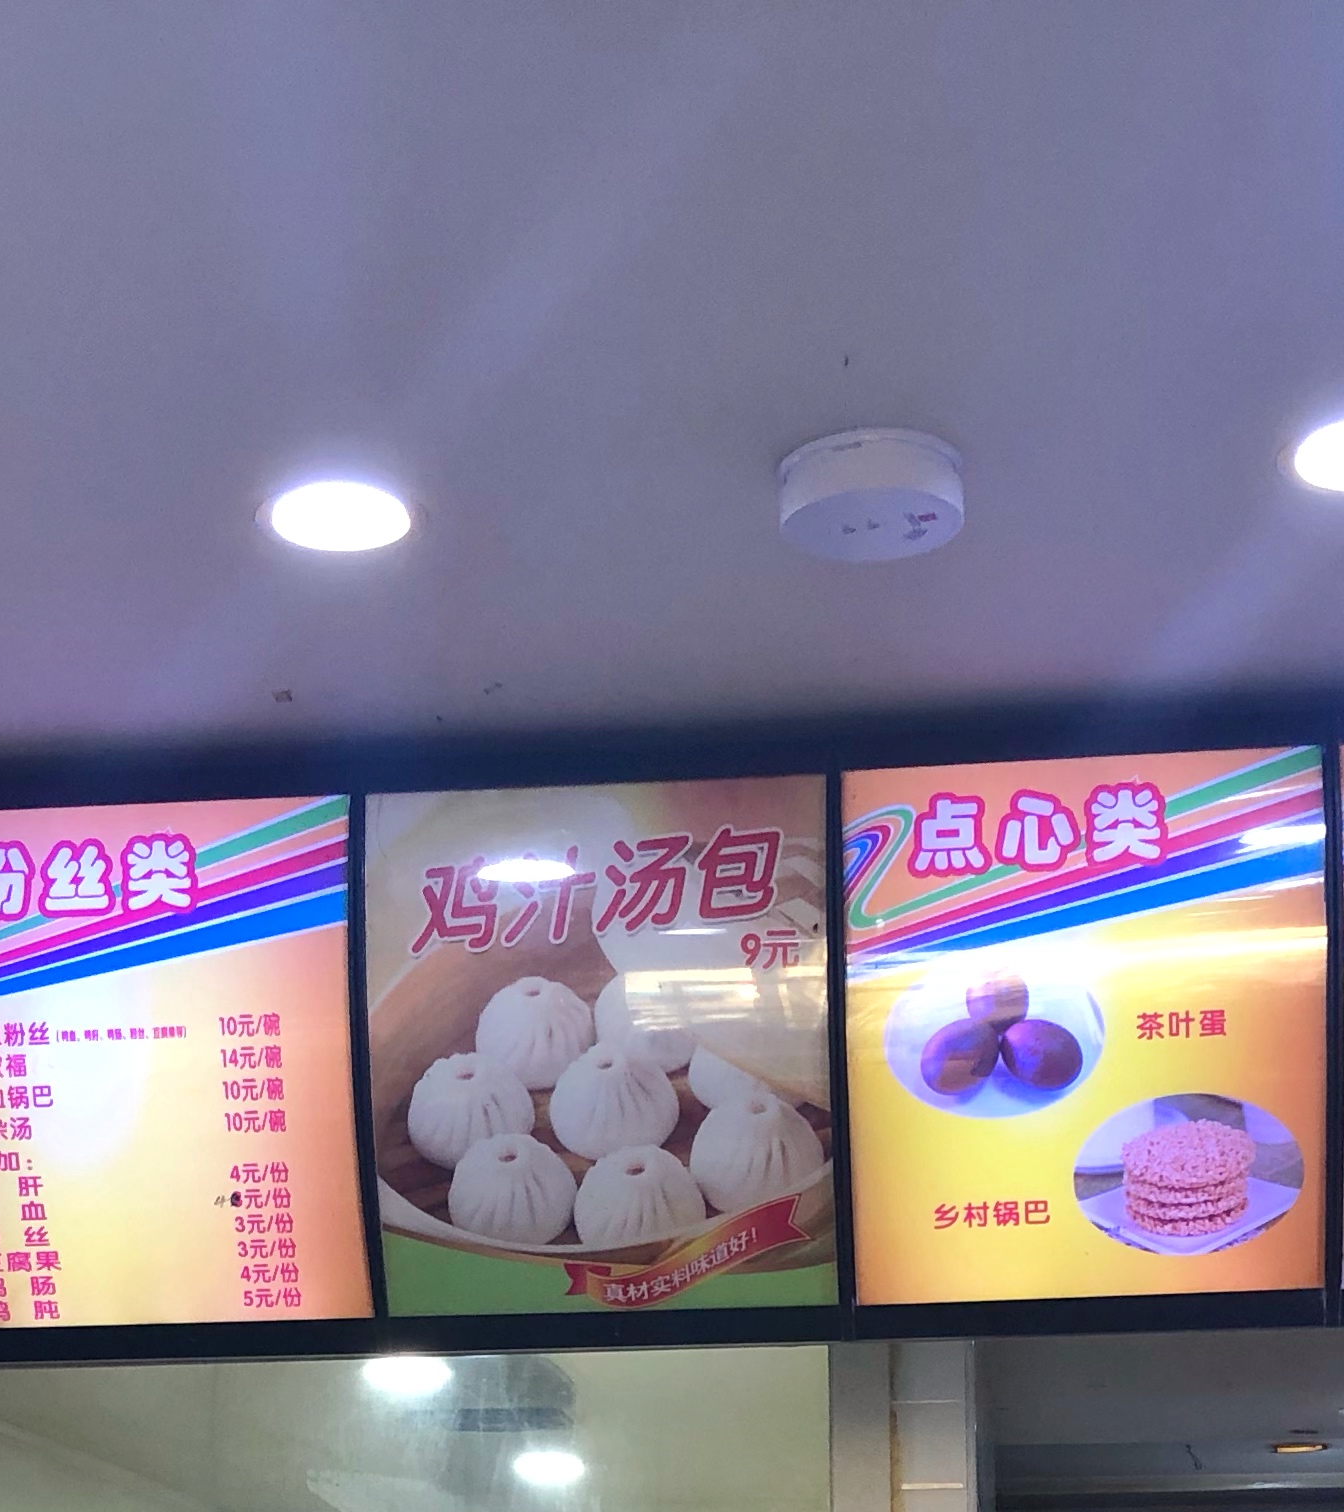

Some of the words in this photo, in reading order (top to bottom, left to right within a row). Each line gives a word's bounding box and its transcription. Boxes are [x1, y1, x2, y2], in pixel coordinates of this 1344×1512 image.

[908, 782, 1169, 878] 点心类
[411, 825, 782, 954] 鸡汁汤包
[741, 929, 799, 969] 9元
[219, 1013, 280, 1038] 10元/碗
[1136, 1010, 1227, 1040] 茶叶蛋
[220, 1045, 283, 1070] 14元/碗
[222, 1077, 285, 1102] 10元/碗
[224, 1109, 287, 1133] 10元/碗
[230, 1161, 289, 1184] 4元/份
[234, 1212, 294, 1235] 3元/份
[933, 1199, 1051, 1230] 乡村锅巴
[238, 1238, 297, 1260] 3元/份
[240, 1263, 299, 1285] 4元/份
[243, 1288, 302, 1309] 5元/份
